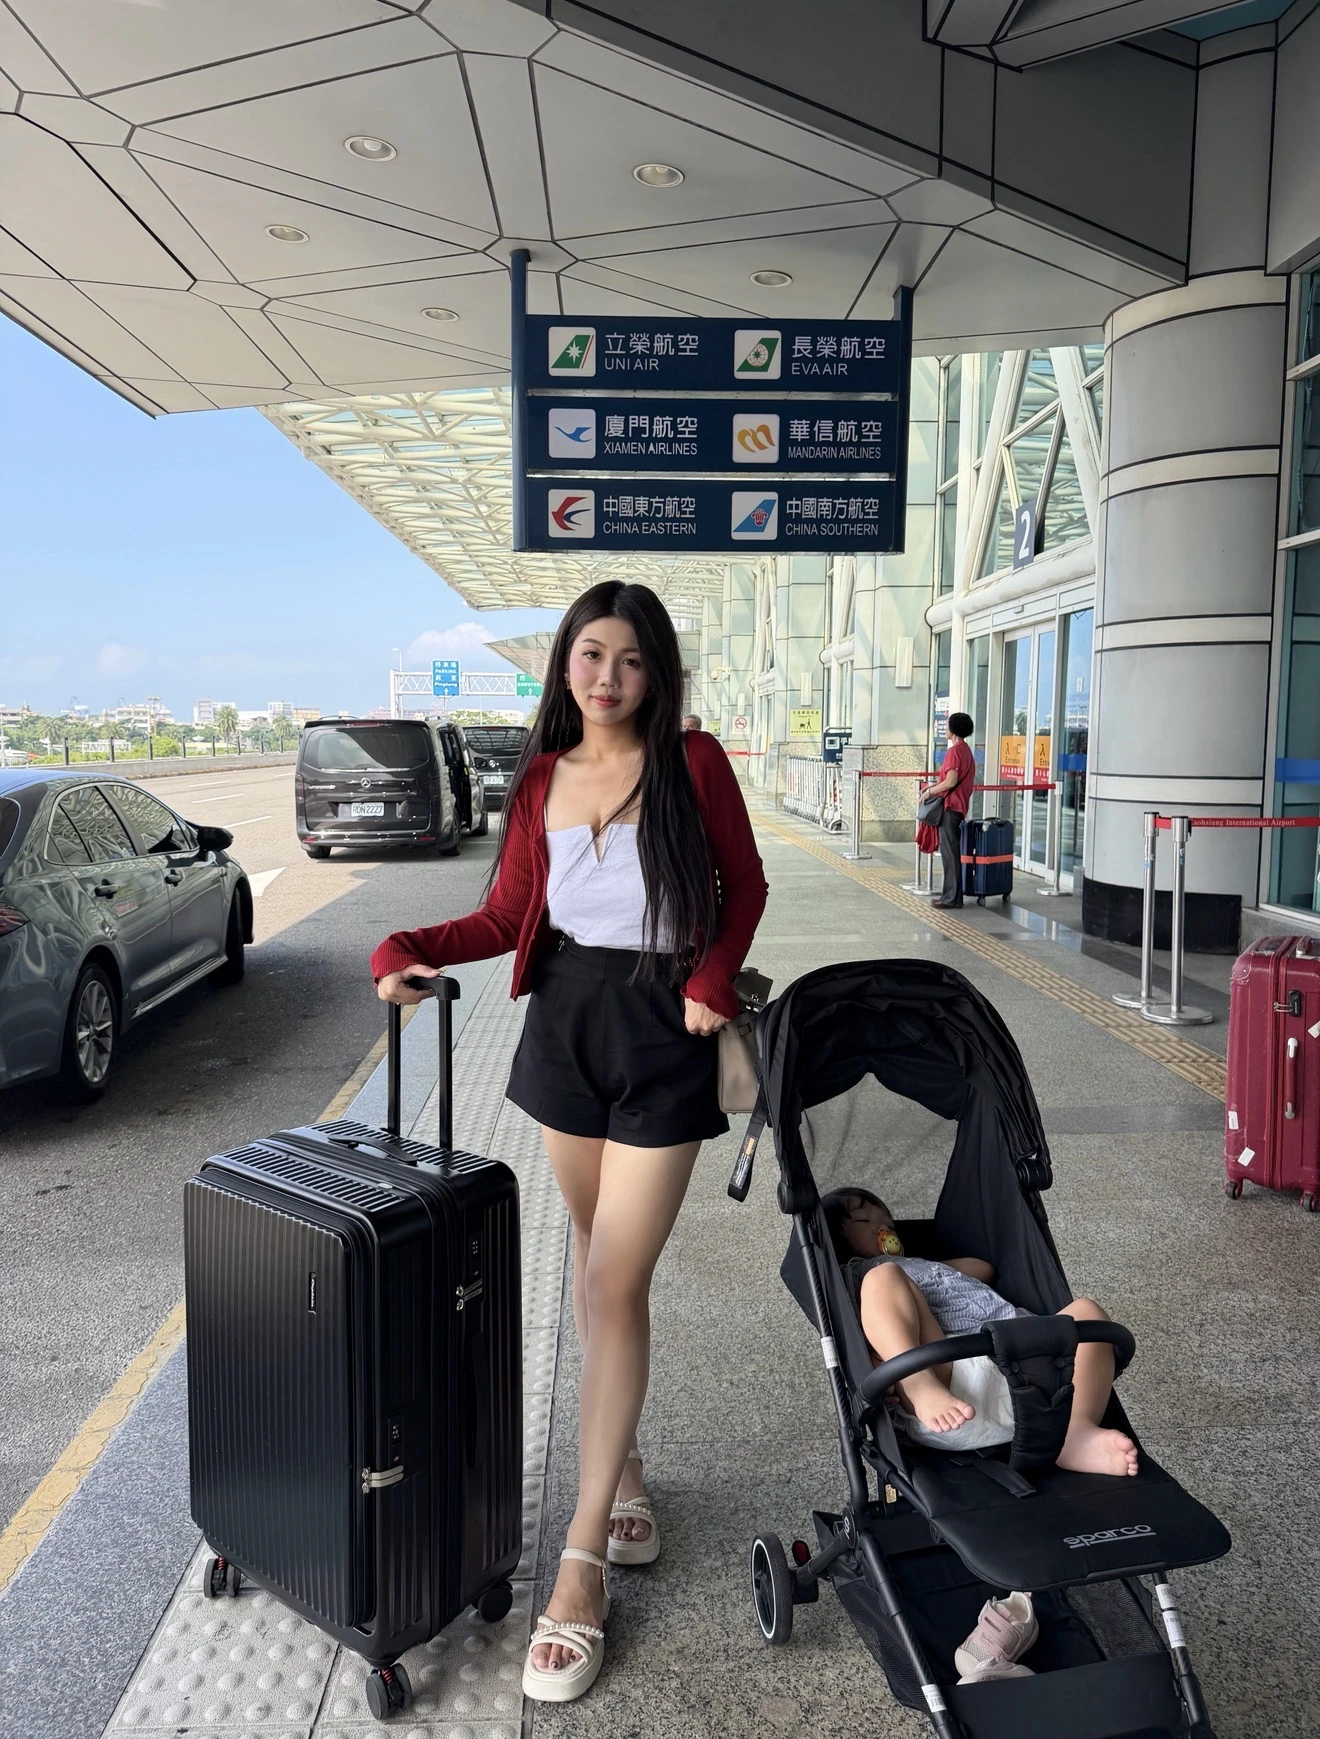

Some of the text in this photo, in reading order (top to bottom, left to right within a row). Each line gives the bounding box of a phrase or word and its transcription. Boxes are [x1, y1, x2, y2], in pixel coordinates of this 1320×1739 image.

[604, 332, 699, 356] 立榮航空
[792, 336, 886, 359] 長榮航空
[604, 358, 659, 371] UNI AIR
[791, 362, 848, 375] EVA AIR
[604, 414, 698, 438] 廈門航空
[789, 419, 882, 442] 華信航空
[603, 441, 698, 455] XIAMEN AIRLINES
[788, 446, 881, 459] MANDARIN AIRLINES
[603, 495, 696, 518] 中國東方航空
[786, 497, 879, 519] 中國南方航空
[603, 521, 696, 535] CHINA EASTERN
[785, 523, 878, 536] CHINA SOUTHERN
[1018, 510, 1031, 560] 2
[1190, 818, 1296, 827] aohsiung International Airport
[1063, 1524, 1152, 1547] sparco
